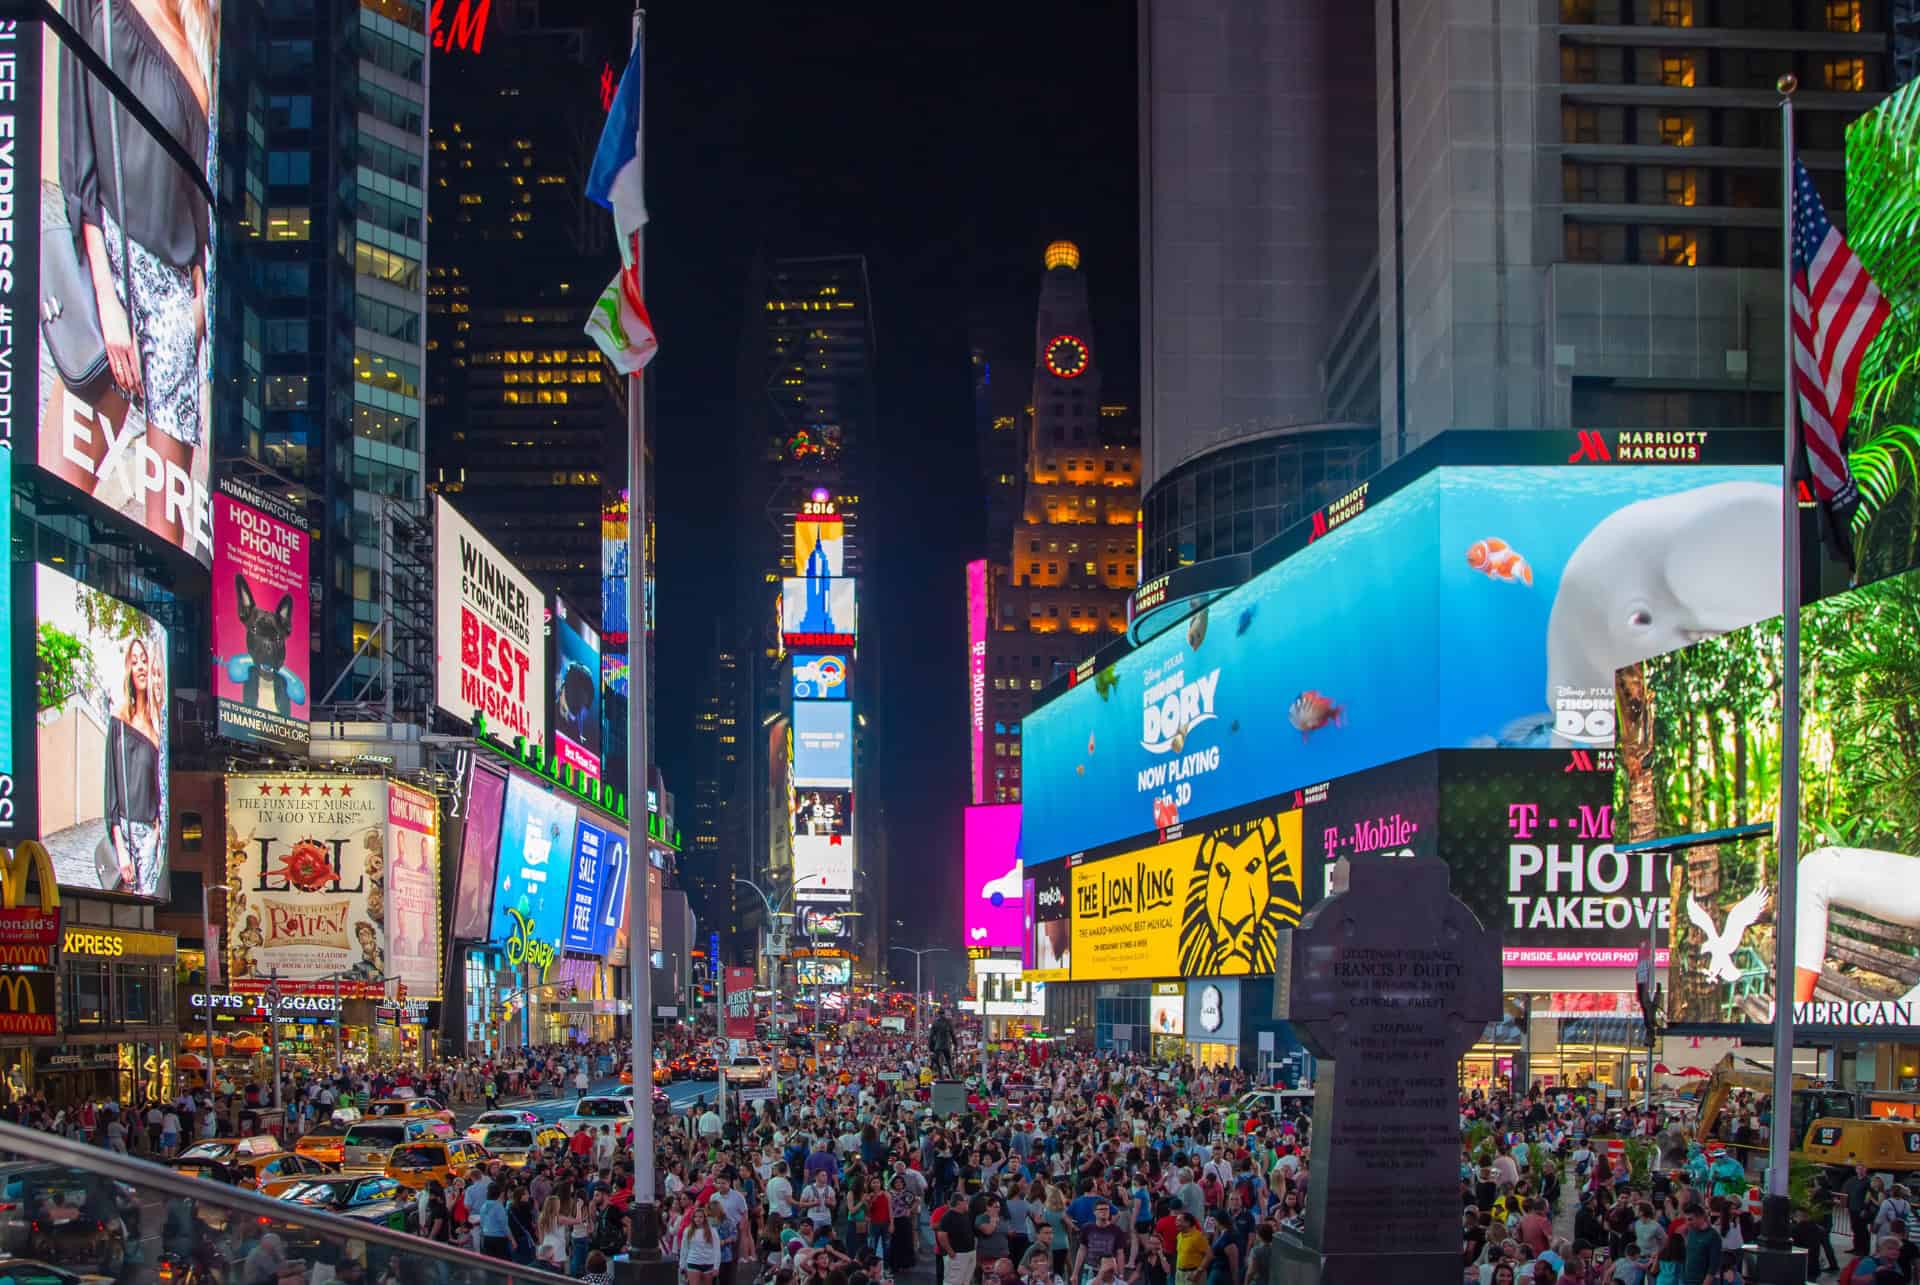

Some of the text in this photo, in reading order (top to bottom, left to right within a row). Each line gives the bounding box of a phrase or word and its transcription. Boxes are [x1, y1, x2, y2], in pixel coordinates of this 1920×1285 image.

[1619, 432, 1708, 444] MARRIOTT
[1619, 446, 1697, 459] MARQUIS
[63, 388, 214, 560] EXPRE
[220, 479, 309, 529] HUMANEWATCH.ORG
[803, 502, 835, 514] 2016
[1328, 482, 1369, 516] MARRIOTT
[230, 503, 300, 552] HOLD THE
[1328, 499, 1365, 529] MARQUIS
[240, 528, 291, 566] PHONE
[459, 536, 530, 626] WINNER!
[462, 576, 530, 645] 6 TONY AWARDS
[784, 633, 854, 645] TOSHIBA
[461, 606, 529, 703] BEST
[461, 668, 530, 738] MUSICAL!
[1143, 670, 1185, 708] FINDING
[1590, 687, 1614, 697] PIXA
[1143, 668, 1221, 744] DORY
[1556, 699, 1615, 710] FINDIN
[220, 709, 310, 744] HUMANEWATCH.ORG
[1556, 711, 1615, 736] DO
[1138, 745, 1220, 793] NOW PLAYING
[237, 798, 375, 811] THE FUNNIEST MUSICAL
[1176, 783, 1191, 807] 3D
[258, 810, 274, 823] IN
[274, 811, 304, 824] 400
[814, 804, 835, 818] 95
[579, 855, 597, 884] SALE
[1509, 844, 1672, 892] PHOT
[1077, 861, 1174, 918] THE LION KING
[0, 917, 55, 930] onald's
[573, 904, 592, 932] FREE
[1506, 896, 1672, 929] TAKEOVE
[63, 932, 123, 956] XPRESS
[1503, 951, 1670, 962] TEP INSIDE. SNAP YOUR PHOT GET
[727, 987, 753, 1005] JERSEY
[730, 1003, 749, 1018] BOYS
[1770, 1000, 1913, 1026] MERICAN
